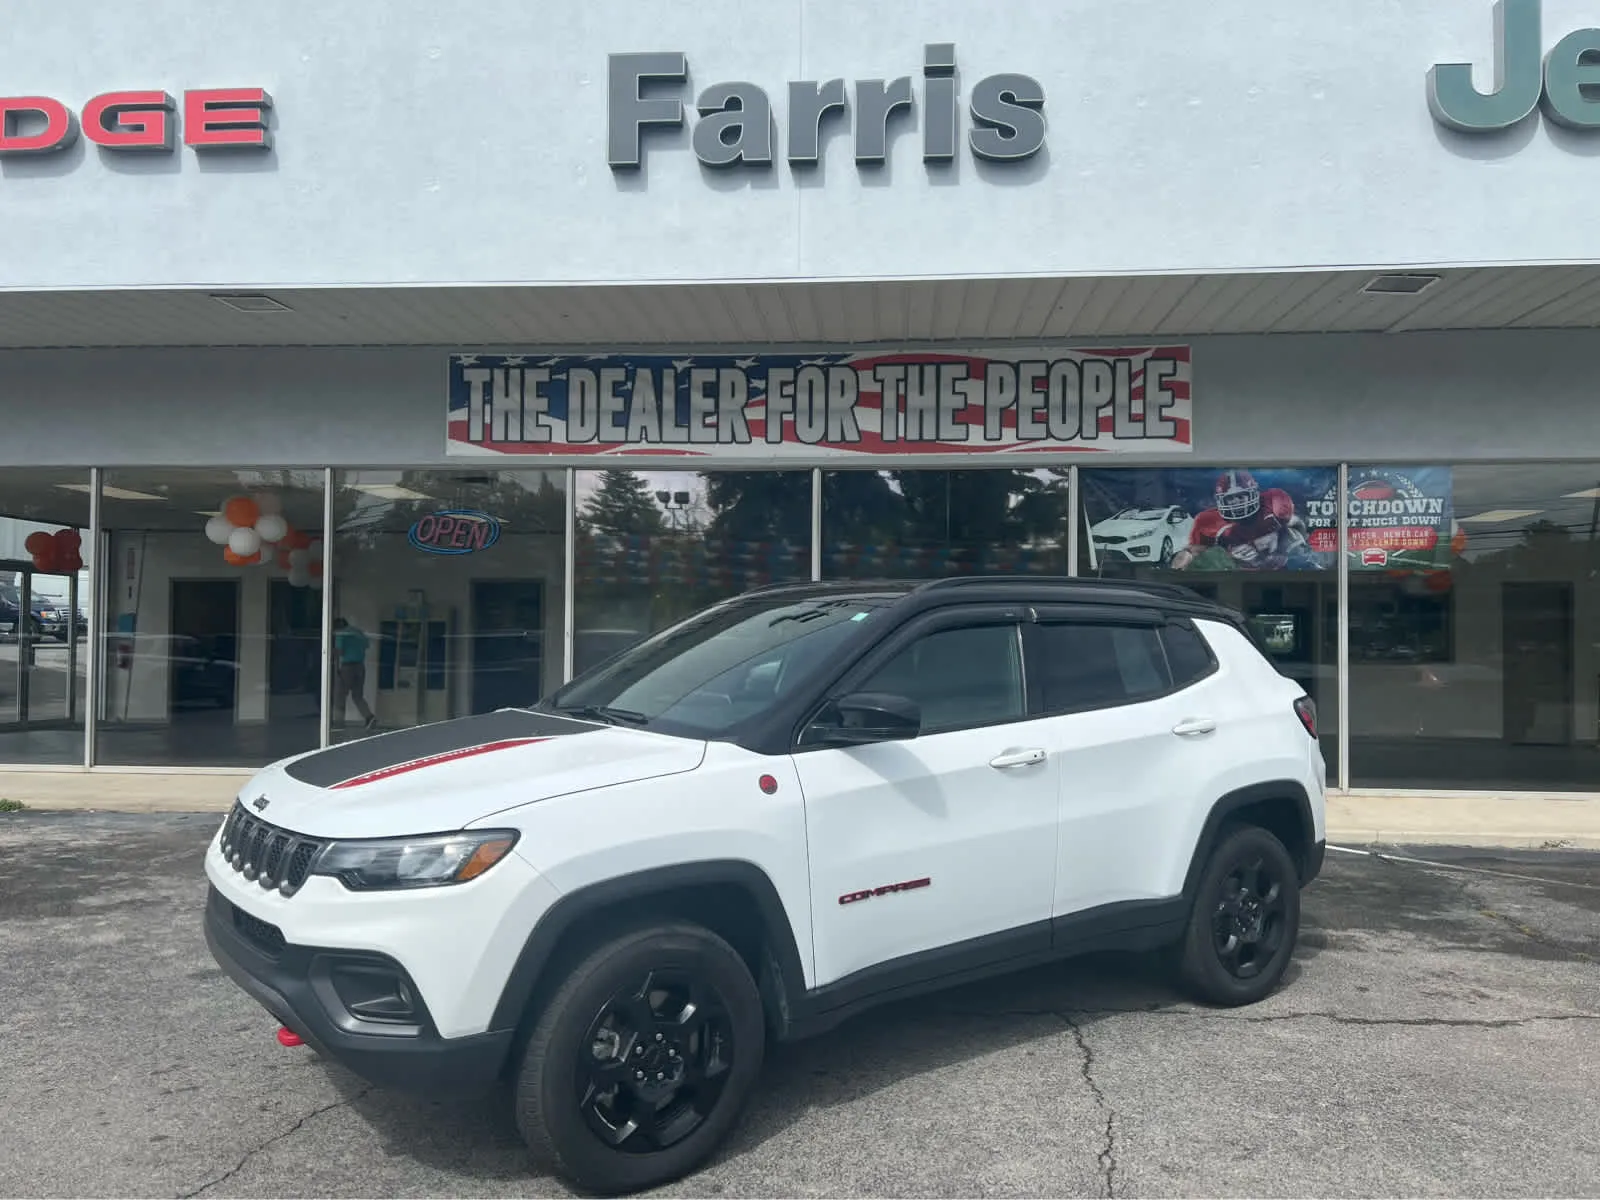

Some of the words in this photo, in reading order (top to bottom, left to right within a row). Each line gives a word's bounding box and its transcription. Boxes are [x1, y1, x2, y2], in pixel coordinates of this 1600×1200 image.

[1425, 0, 1600, 133] Je
[607, 43, 1046, 168] Farris
[463, 366, 553, 443] THE
[566, 366, 752, 443] DEALER
[765, 364, 861, 444] FOR
[873, 360, 969, 442] THE
[984, 358, 1177, 441] PEOPLE
[1306, 498, 1444, 516] TOCHDOWN
[1308, 518, 1331, 527] FOR
[1361, 516, 1398, 527] MUCH
[417, 515, 488, 549] OPEN
[838, 877, 932, 905] COMPA
